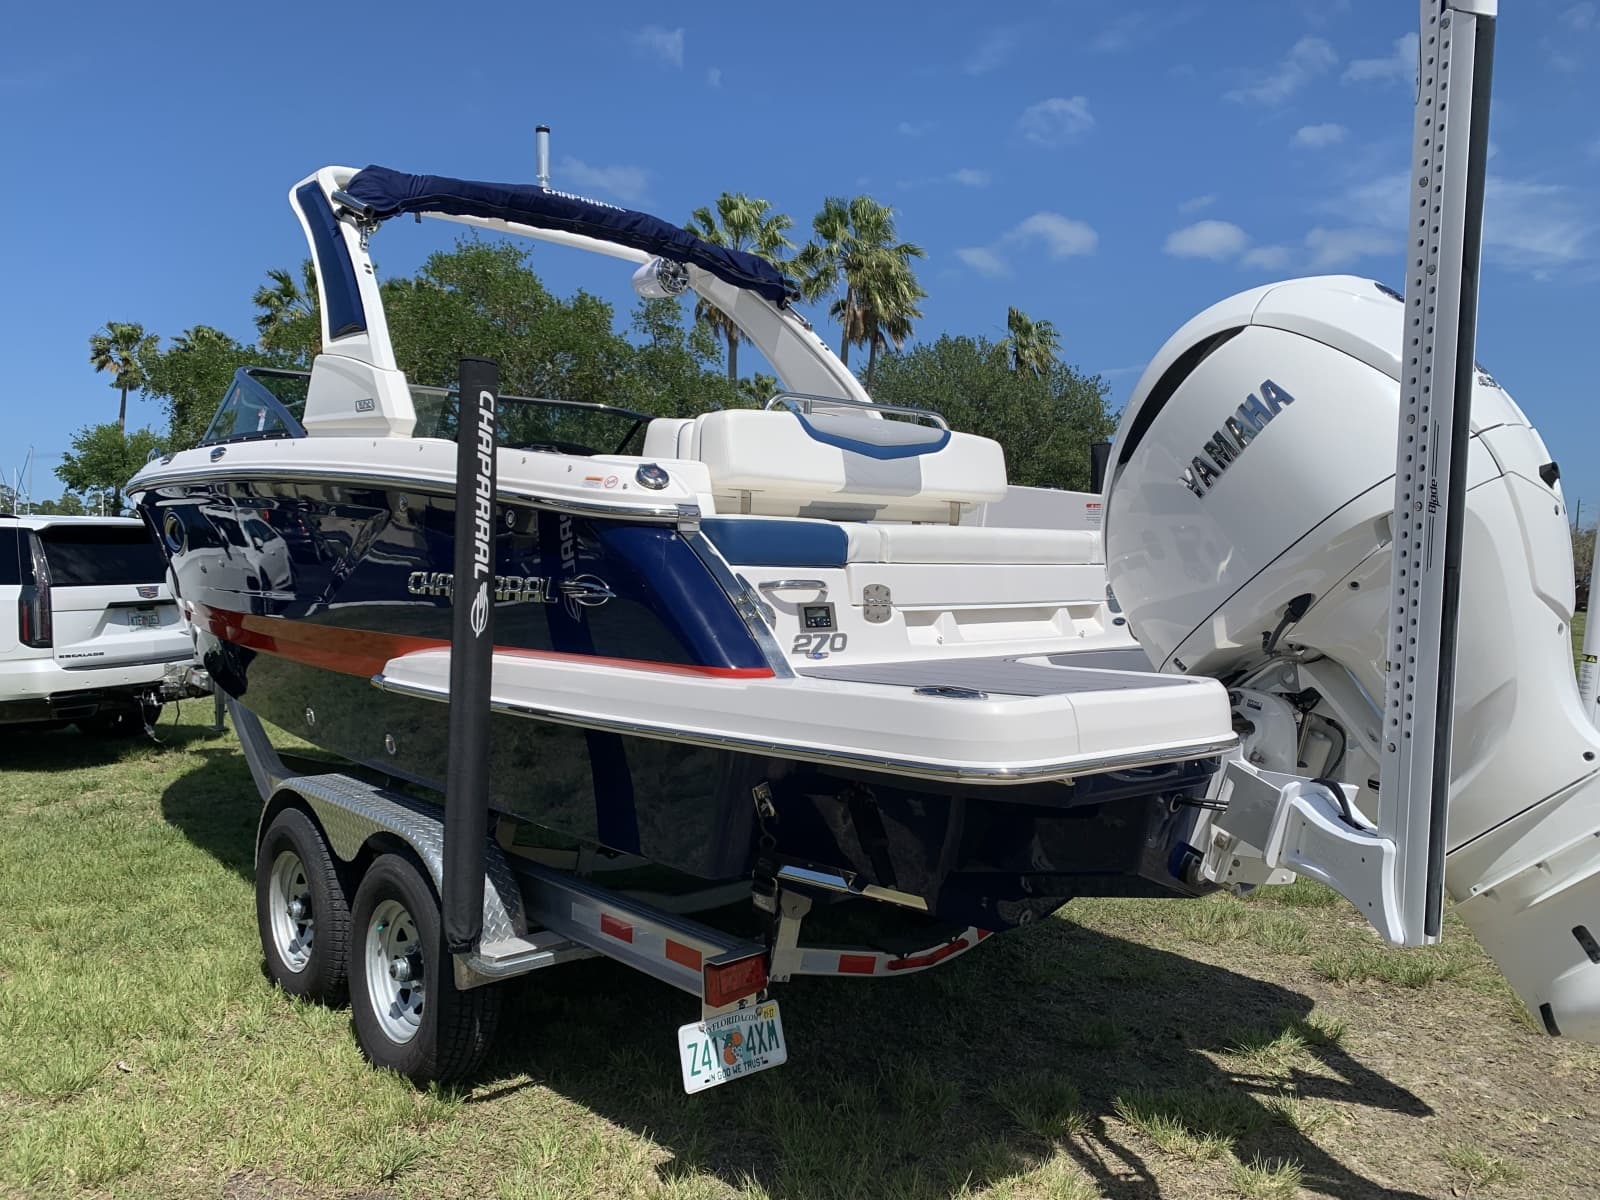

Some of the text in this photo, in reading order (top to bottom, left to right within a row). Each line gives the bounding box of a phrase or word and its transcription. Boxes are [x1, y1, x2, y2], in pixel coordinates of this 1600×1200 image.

[1178, 379, 1296, 500] YAMAHA
[474, 390, 495, 580] CHAPARRAL
[1428, 478, 1441, 514] Blade
[58, 651, 105, 659] ESCALADE
[791, 632, 848, 654] 270
[687, 1020, 780, 1077] Z41 4XM
[717, 1067, 732, 1081] GOD
[732, 1063, 742, 1075] WE
[743, 1056, 765, 1072] TRUST
